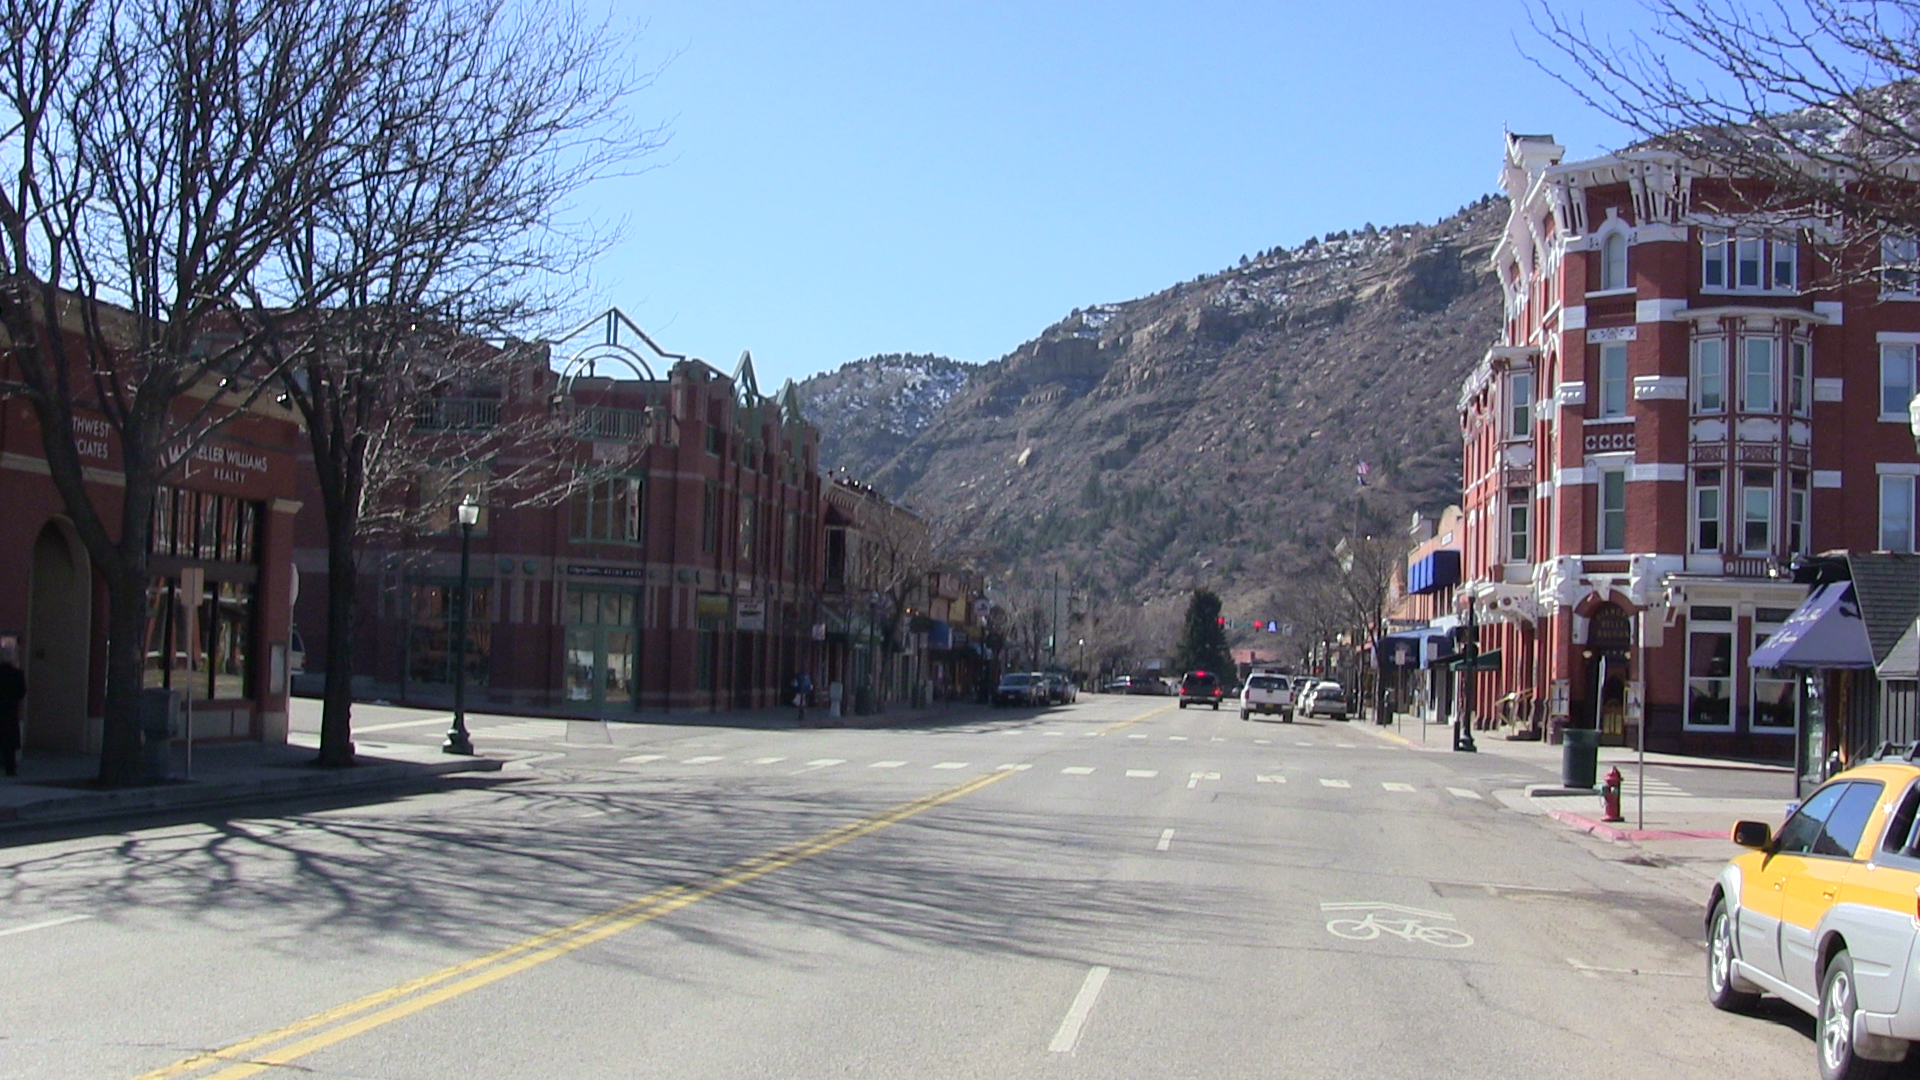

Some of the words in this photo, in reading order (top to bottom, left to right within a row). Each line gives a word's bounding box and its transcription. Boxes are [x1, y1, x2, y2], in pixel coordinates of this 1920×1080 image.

[72, 416, 111, 438] THWEST
[226, 447, 268, 472] WILLIAMS
[213, 467, 246, 484] REALTY
